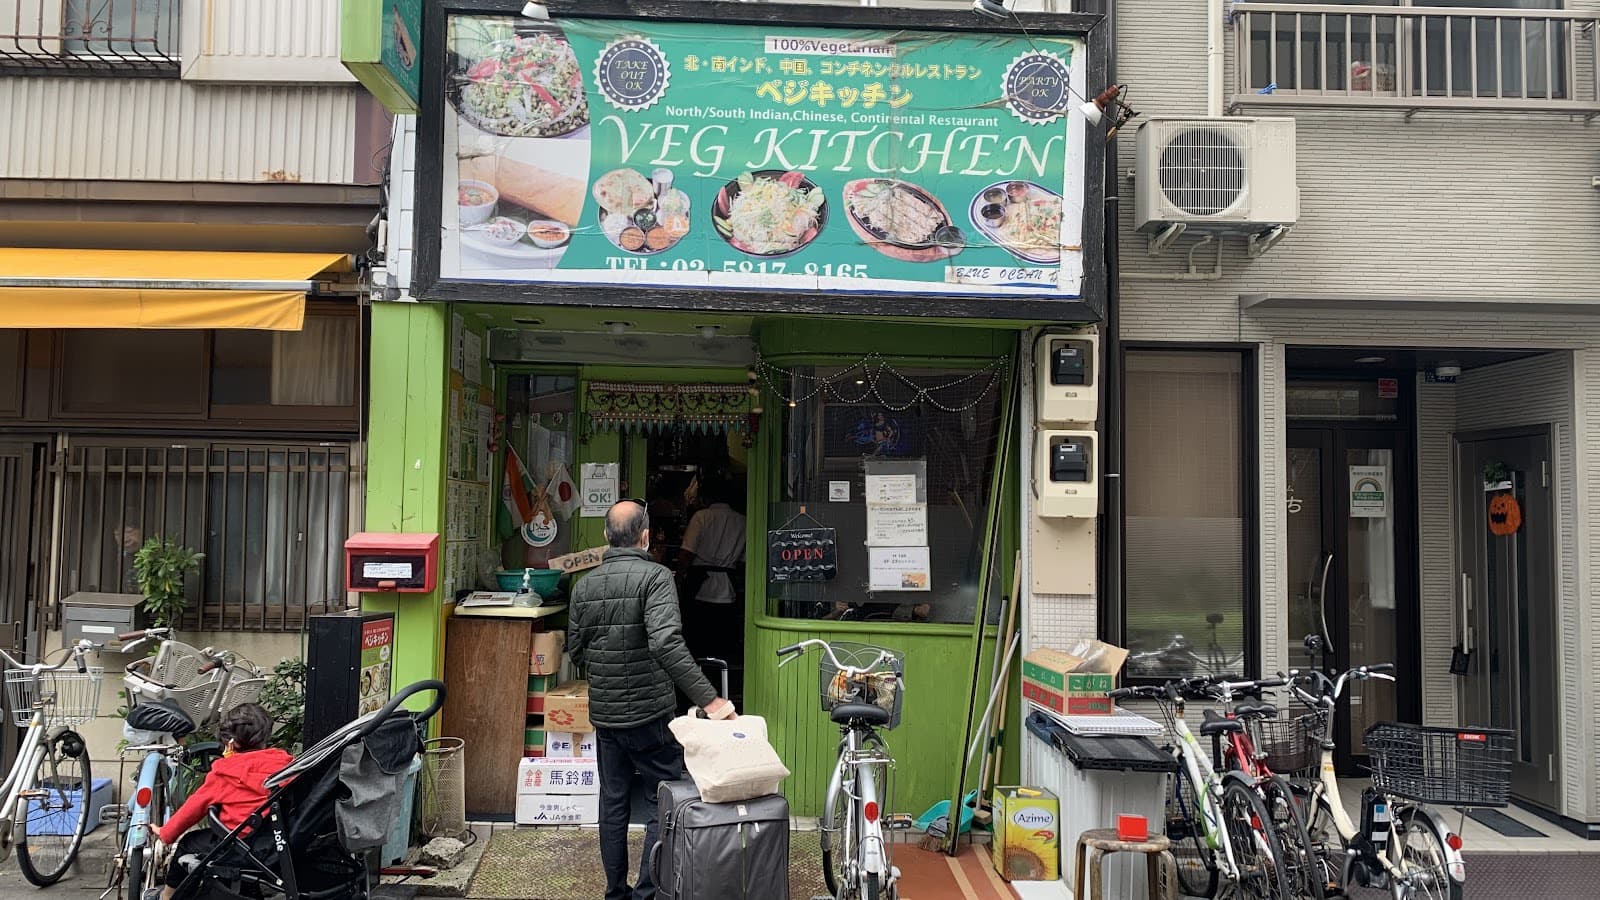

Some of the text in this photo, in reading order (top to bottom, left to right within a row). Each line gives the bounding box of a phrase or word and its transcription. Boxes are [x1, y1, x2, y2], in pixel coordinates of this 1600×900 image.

[614, 59, 649, 70] TAKE
[620, 70, 648, 81] OUT
[1019, 75, 1059, 88] PARTY
[625, 81, 644, 90] OK
[756, 80, 913, 108] ベジキッチン
[1031, 88, 1050, 98] OK
[666, 105, 745, 119] North/South
[851, 112, 924, 126] Continental
[929, 114, 999, 127] Restaurant
[598, 115, 1064, 178] VEG KITCHEN
[956, 267, 991, 279] BLUE
[999, 268, 1043, 280] OCEAN
[588, 493, 611, 503] OK!
[563, 552, 600, 569] OPEN
[781, 548, 824, 561] OPEN
[1073, 678, 1108, 690] こがね
[549, 770, 594, 786] 馬鈴薯
[1017, 813, 1051, 823] Azime
[273, 829, 287, 852] Joie
